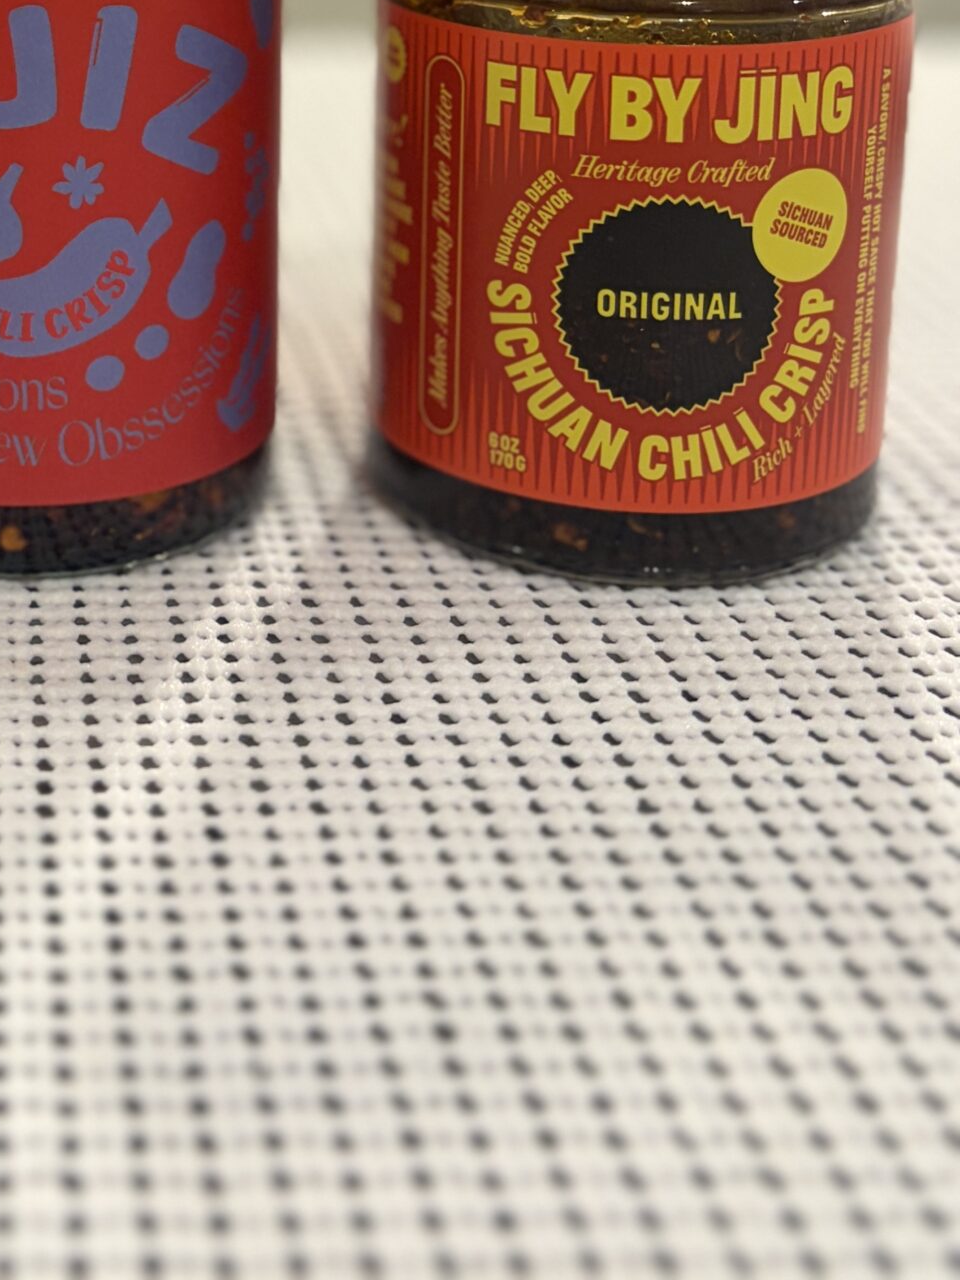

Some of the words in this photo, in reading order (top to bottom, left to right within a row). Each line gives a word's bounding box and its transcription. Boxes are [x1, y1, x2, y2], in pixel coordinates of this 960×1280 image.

[882, 68, 892, 79] A
[433, 82, 453, 160] Better
[486, 61, 593, 137] FLY
[609, 75, 703, 144] BY
[524, 169, 564, 204] DEEP,
[571, 154, 681, 187] Heritage
[687, 156, 776, 188] Crafted
[863, 124, 878, 201] YOURSELF
[874, 146, 887, 200] CRISPY
[431, 160, 451, 226] Taste
[778, 200, 834, 231] SICHUAN
[871, 203, 883, 233] HOT
[513, 234, 537, 274] BOLD
[527, 187, 575, 238] FLAVOR
[770, 218, 828, 249] SOURCED
[858, 203, 872, 269] PUTTING
[856, 271, 867, 295] ON
[867, 236, 880, 286] SAUCE
[43, 248, 136, 340] CRISP
[597, 288, 743, 321] ORIGINAL
[864, 287, 876, 325] THAT
[849, 297, 865, 389] EVERYTHING
[861, 328, 872, 358] YOU
[752, 437, 794, 484] Rich
[802, 331, 847, 427] Layered
